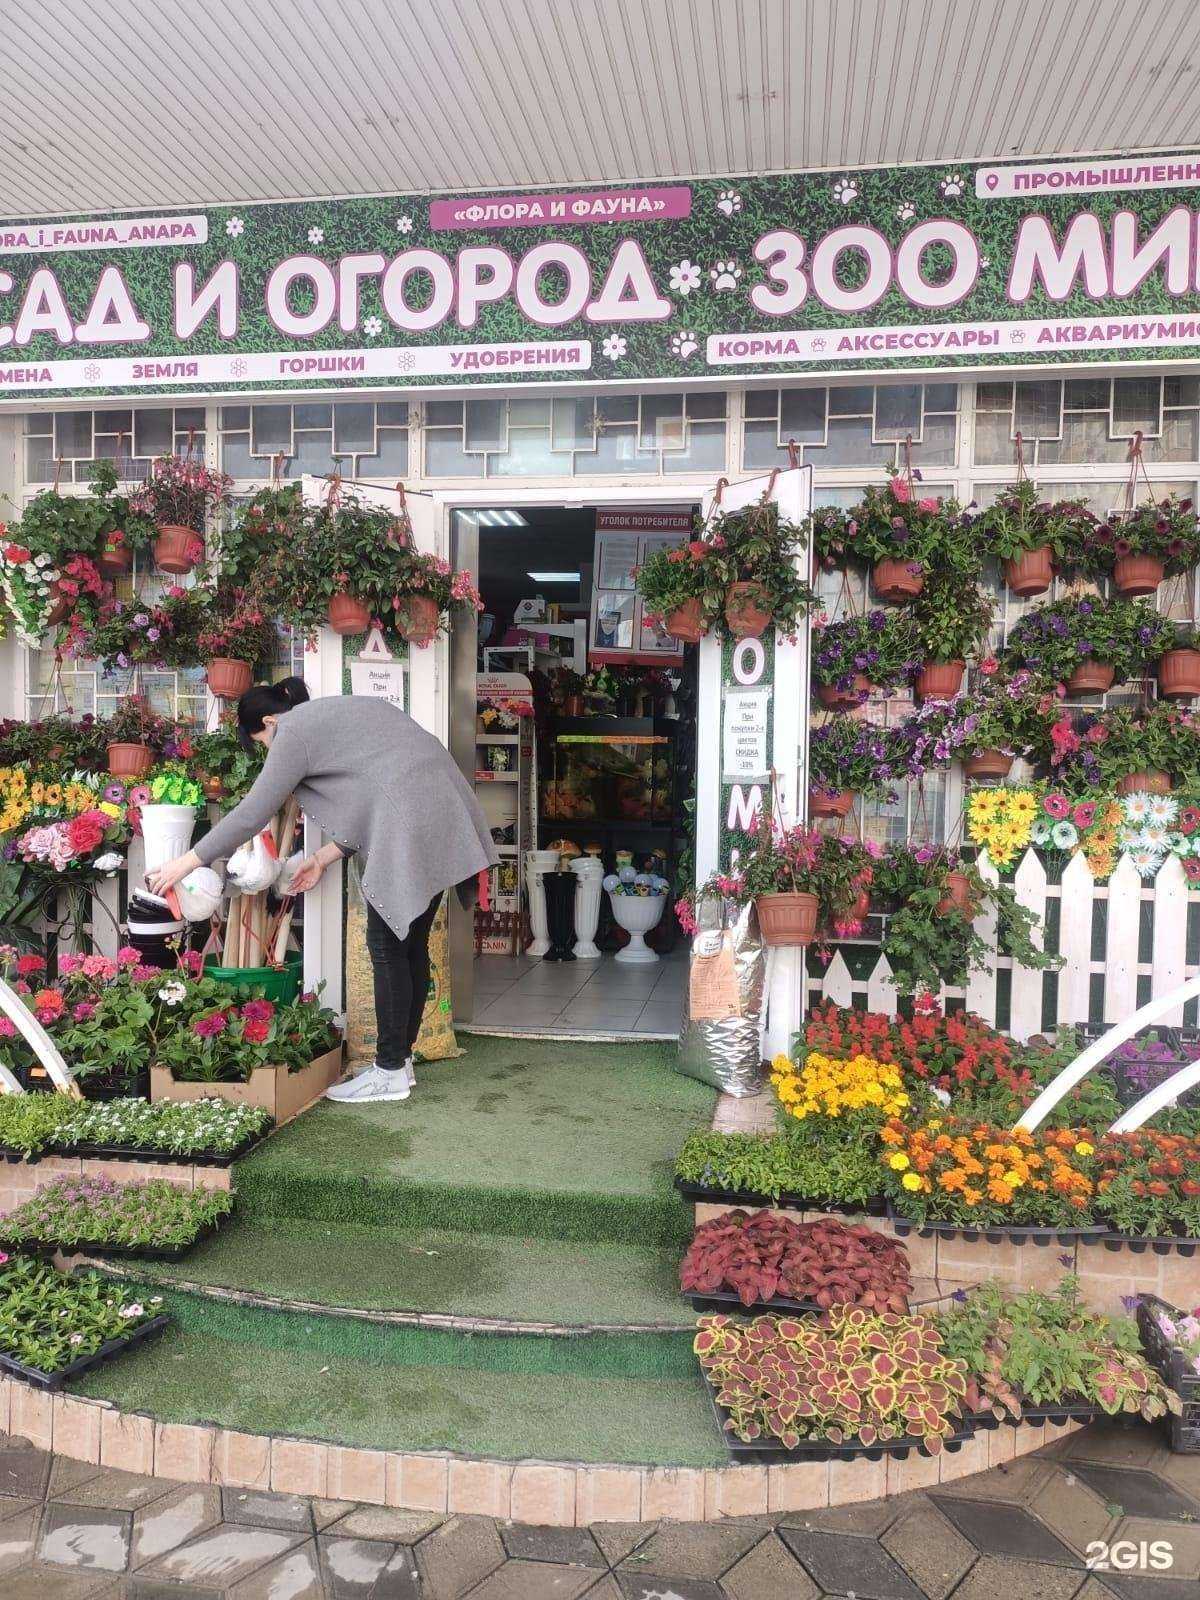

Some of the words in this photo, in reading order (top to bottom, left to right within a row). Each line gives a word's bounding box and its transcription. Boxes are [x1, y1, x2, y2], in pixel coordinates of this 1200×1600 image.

[1014, 164, 1200, 190] ПРОМЫШЛЕНН
[454, 201, 545, 222] «ФЛОРА
[549, 200, 566, 217] И
[571, 195, 666, 217] ФАУНА»
[751, 218, 980, 316] ЗОО
[1007, 206, 1200, 302] МИ
[0, 265, 152, 346] АД
[174, 259, 238, 341] И
[266, 238, 673, 336] ОГОРОД
[718, 337, 800, 358] КОРМА
[836, 329, 1000, 352] АКСЕССУАРЫ
[131, 361, 199, 379] ЗЕМЛЯ
[279, 355, 366, 374] ГОРШКИ
[450, 347, 581, 371] УДОБРЕНИЯ
[600, 516, 630, 527] УГОЛОК
[632, 517, 689, 527] ПОТРЕБИТЕЛЯ
